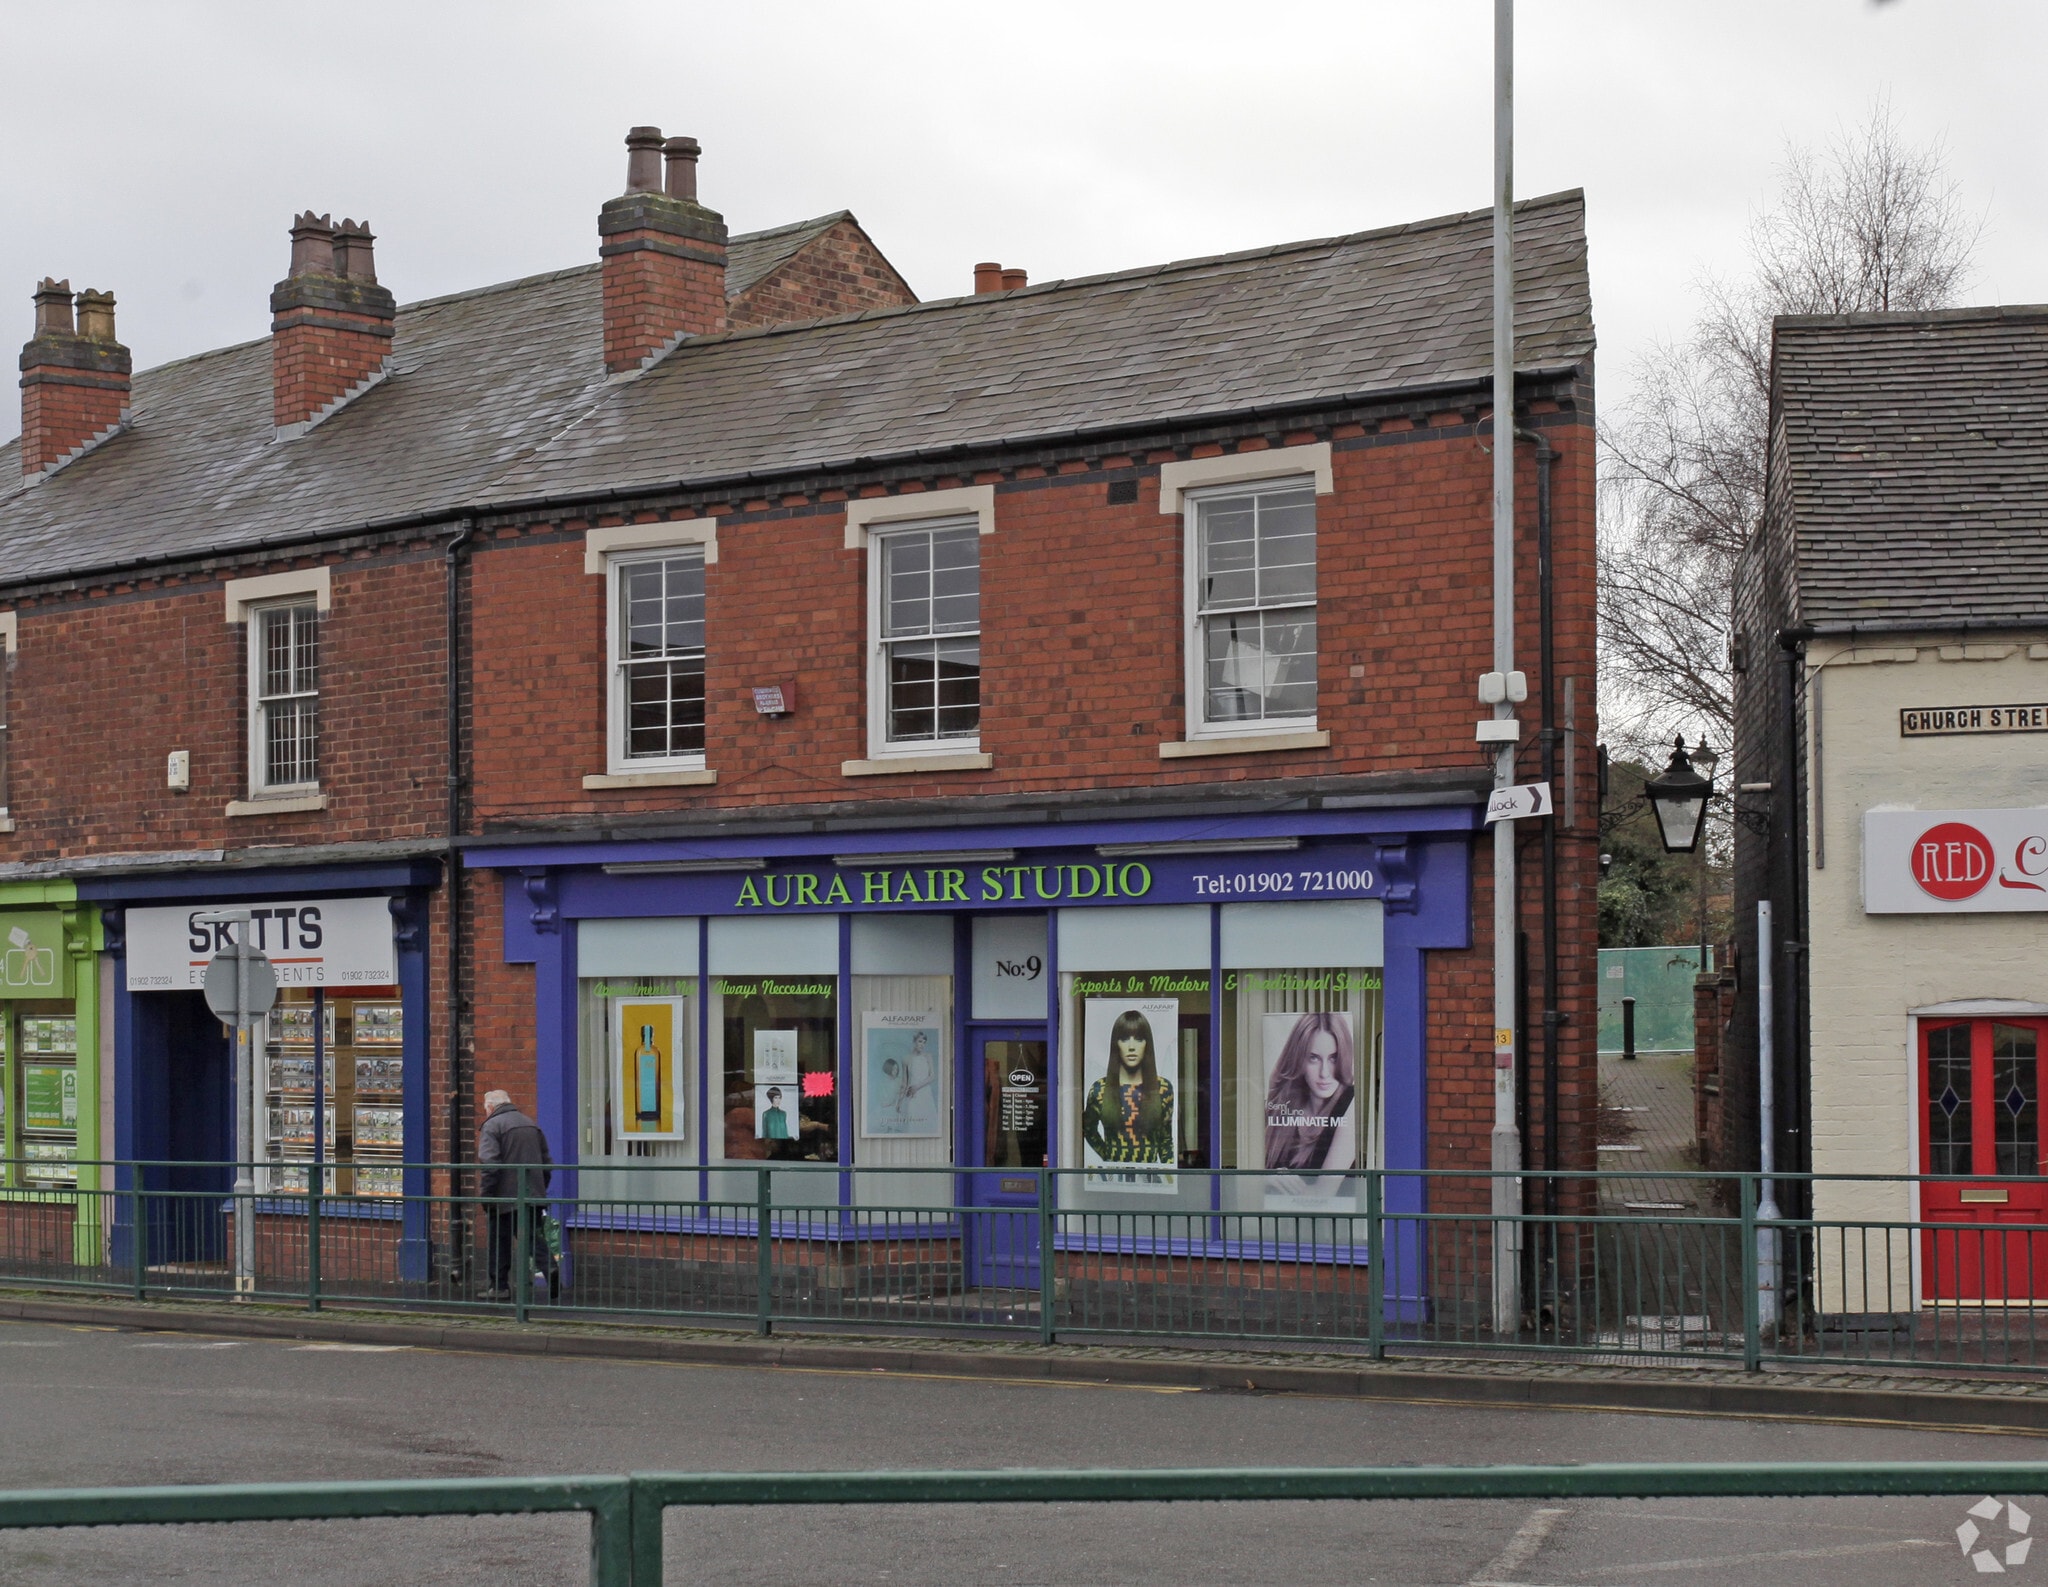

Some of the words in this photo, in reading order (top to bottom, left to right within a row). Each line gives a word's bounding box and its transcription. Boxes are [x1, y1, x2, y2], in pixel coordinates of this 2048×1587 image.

[1907, 709, 1981, 731] CHURCH
[1990, 706, 2048, 728] STRE
[1921, 842, 1987, 883] RED
[735, 873, 852, 907] AURA
[861, 869, 970, 904] HAIR
[982, 863, 1152, 900] STUDIO
[1299, 870, 1374, 891] 721000
[188, 906, 323, 953] SKTTS
[129, 976, 150, 986] 01902
[151, 975, 174, 985] 732324
[274, 966, 325, 983] GENTS
[341, 971, 363, 982] 01902
[364, 970, 390, 981] 732324
[1224, 973, 1238, 990] &
[1242, 972, 1331, 993] Traditional
[1332, 972, 1382, 992] Styles
[593, 980, 671, 999] Appointments
[712, 979, 758, 999] Always
[761, 979, 833, 999] Neccessary
[1070, 976, 1122, 997] Experts
[1126, 976, 1145, 993] In
[1149, 975, 1210, 993] Modern
[1011, 1074, 1032, 1082] OPEN
[1267, 1116, 1329, 1127] ILLUMINATE
[1330, 1116, 1348, 1127] ME
